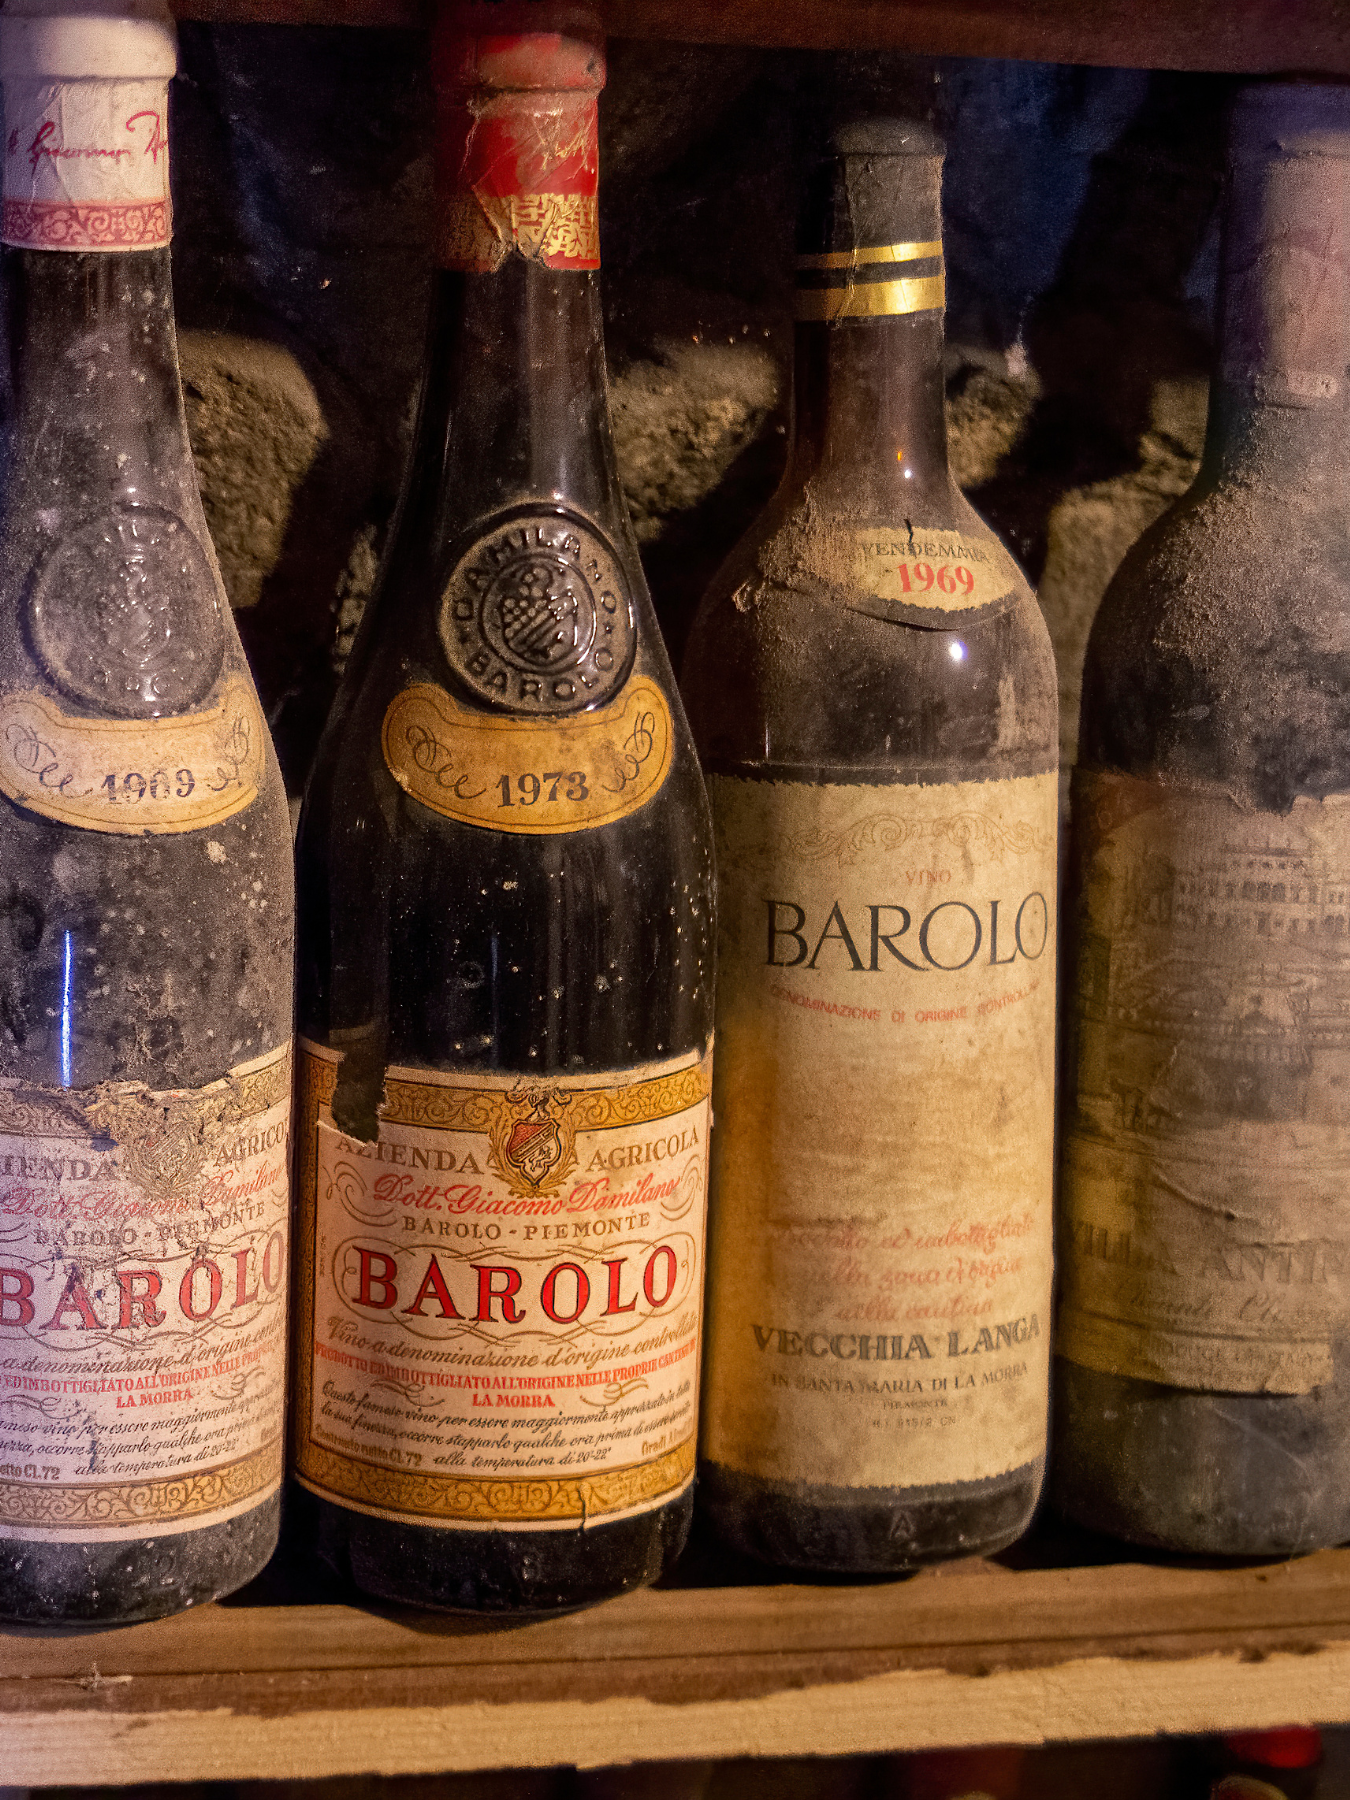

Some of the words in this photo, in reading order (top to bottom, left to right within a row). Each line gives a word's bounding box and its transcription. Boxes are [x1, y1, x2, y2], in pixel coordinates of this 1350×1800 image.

[857, 541, 991, 564] VENDEMMIA
[898, 562, 975, 596] 1969
[496, 770, 590, 809] 1973
[905, 869, 952, 887] VINO
[760, 891, 1048, 971] BAROLO
[891, 1010, 906, 1024] DI
[914, 1005, 968, 1024] ORIGINE
[213, 1121, 288, 1167] AGRICO
[585, 1124, 699, 1173] AGRICOLA
[373, 1172, 443, 1211] Dott.
[444, 1184, 565, 1216] Giacomo
[566, 1172, 681, 1214] Damilano
[402, 1215, 502, 1241] BAROLO
[522, 1211, 651, 1241] PIEMONTE
[352, 1245, 678, 1325] BAROLO
[327, 1315, 368, 1348] Vino
[389, 1340, 539, 1368] denominazione
[542, 1338, 634, 1370] d'origine
[751, 1323, 932, 1361] VECCHIA
[947, 1313, 1041, 1358] LANGA
[20, 1352, 174, 1374] denominazione
[179, 1335, 251, 1367] d'origine
[4, 1374, 22, 1388] ED
[23, 1375, 136, 1395] IMBOTTIGLIATO
[136, 1365, 212, 1391] ALL'ORIGINE
[212, 1358, 240, 1377] NELLE
[386, 1361, 491, 1390] IMBOTTIGLIATO
[492, 1374, 576, 1391] ALL'ORIGINE
[576, 1370, 612, 1388] NELLE
[612, 1360, 658, 1383] PROPRIE
[771, 1373, 789, 1388] IN
[797, 1375, 856, 1393] SANTA
[861, 1378, 925, 1394] MARIA
[932, 1378, 947, 1391] DI
[954, 1374, 976, 1390] LA
[981, 1362, 1027, 1386] MORRA
[116, 1391, 138, 1409] LA
[139, 1388, 194, 1406] MORRA
[404, 1407, 438, 1423] vino
[437, 1415, 468, 1429] per
[468, 1416, 509, 1429] essere
[512, 1405, 608, 1434] maggiormente
[610, 1389, 667, 1425] apprezzato
[472, 1393, 494, 1408] LA
[496, 1394, 556, 1408] MORRA
[42, 1421, 77, 1435] vino
[109, 1419, 149, 1434] essere
[150, 1401, 238, 1434] maggiormente
[321, 1400, 333, 1416] la
[333, 1410, 352, 1423] sua
[399, 1432, 444, 1445] occorre
[446, 1431, 511, 1452] stapparlo
[513, 1430, 568, 1452] qualche
[569, 1435, 593, 1447] ora
[593, 1428, 633, 1449] prima
[37, 1442, 88, 1455] occorre
[152, 1427, 202, 1456] qualche
[203, 1429, 226, 1441] ora
[111, 1454, 193, 1475] temperatura
[433, 1451, 467, 1466] alla
[472, 1453, 555, 1471] temperatura
[560, 1451, 576, 1466] di
